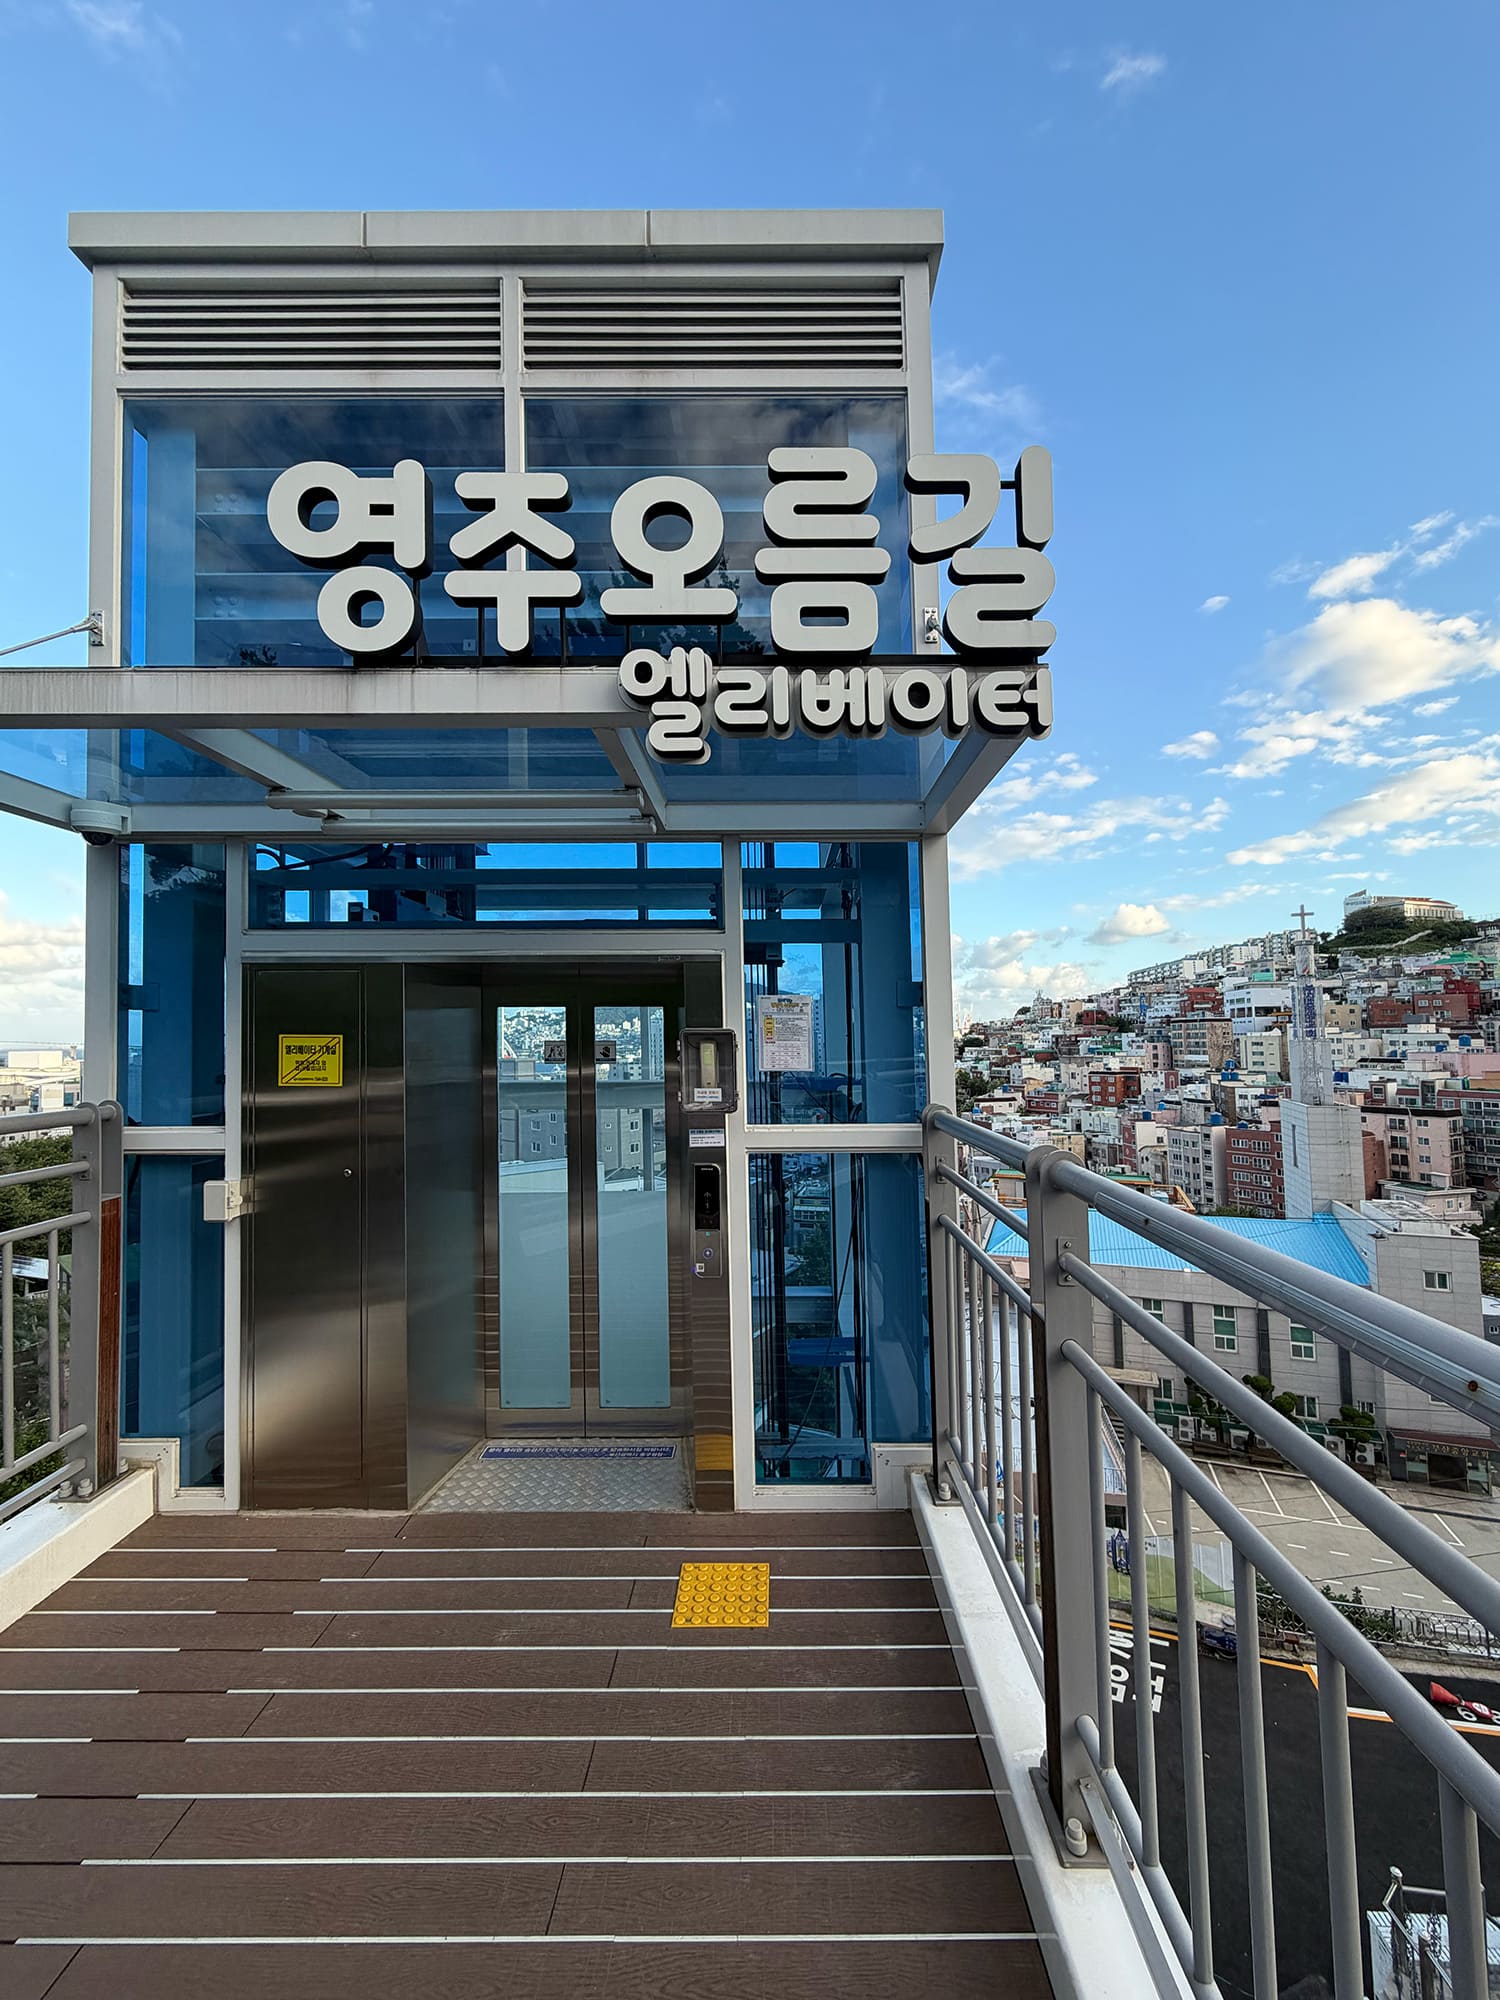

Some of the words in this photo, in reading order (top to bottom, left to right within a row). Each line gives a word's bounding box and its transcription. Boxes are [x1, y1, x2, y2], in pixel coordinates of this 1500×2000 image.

[267, 446, 1057, 660] 영주오름길
[618, 645, 1054, 757] 엘리베이터
[285, 1044, 317, 1056] 엘리베이터
